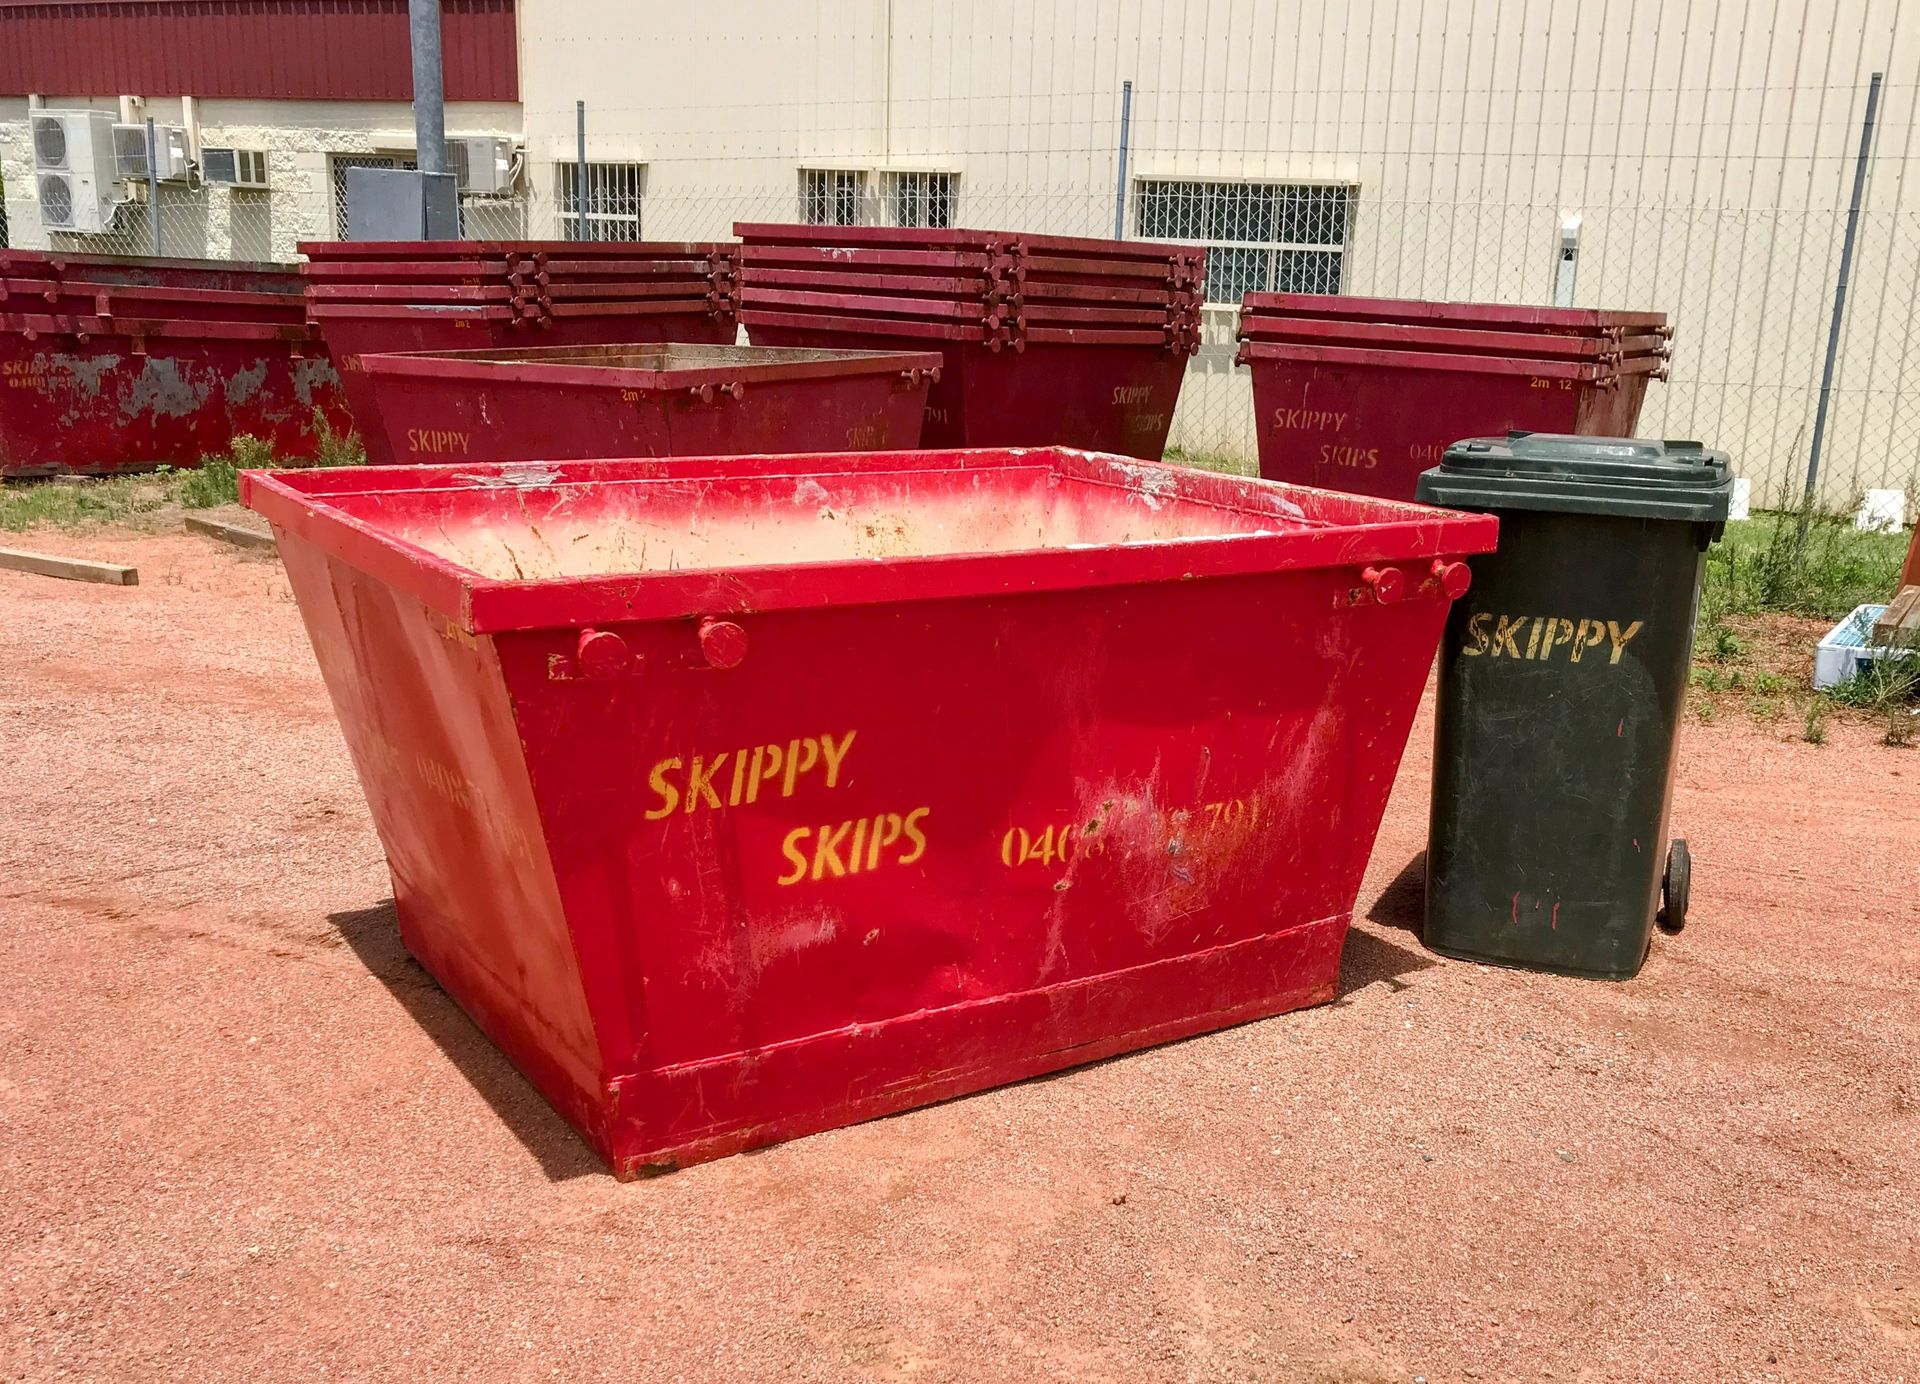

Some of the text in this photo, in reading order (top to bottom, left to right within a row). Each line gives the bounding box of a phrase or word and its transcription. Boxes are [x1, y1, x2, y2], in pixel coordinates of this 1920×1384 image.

[1111, 385, 1153, 405] SKIPPY
[1530, 376, 1572, 390] 2m 12
[1273, 407, 1347, 432] SKIPPY
[407, 428, 470, 454] SKIPPY
[1319, 444, 1378, 469] SKIPS
[1462, 612, 1645, 665] SKIPPY
[644, 730, 857, 820] SKIPPY
[777, 806, 931, 886] SKIPS
